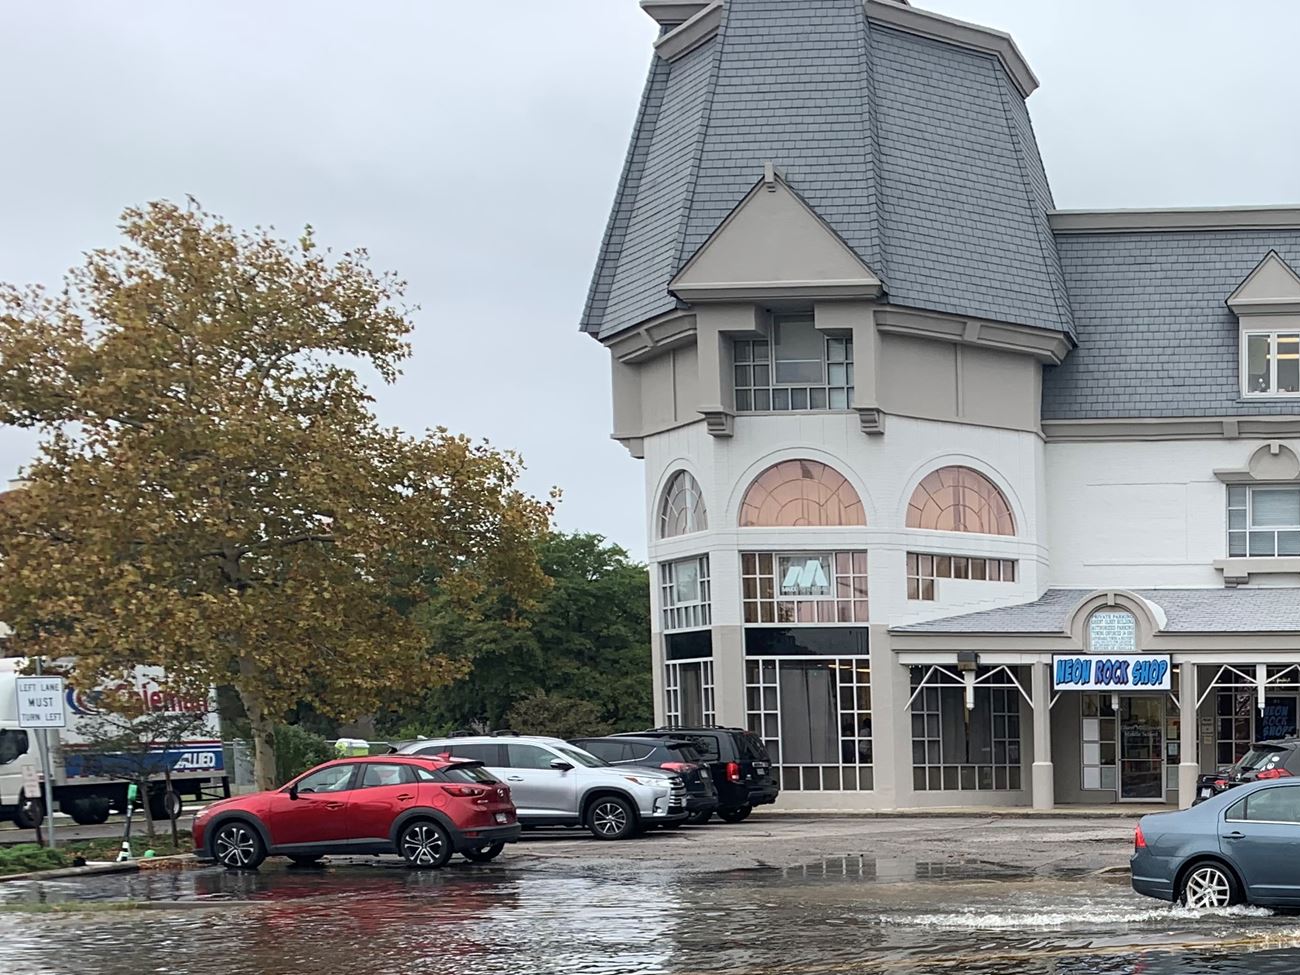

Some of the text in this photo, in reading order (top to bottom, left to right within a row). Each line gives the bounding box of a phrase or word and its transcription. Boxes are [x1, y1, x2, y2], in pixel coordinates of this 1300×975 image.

[1056, 658, 1168, 685] NEON ROCK SHOP
[19, 682, 60, 692] LEFT LANE
[27, 696, 53, 707] MUST
[21, 712, 61, 721] TURN LEFT
[1263, 716, 1289, 726] ROCK
[173, 752, 216, 769] ALLIED
